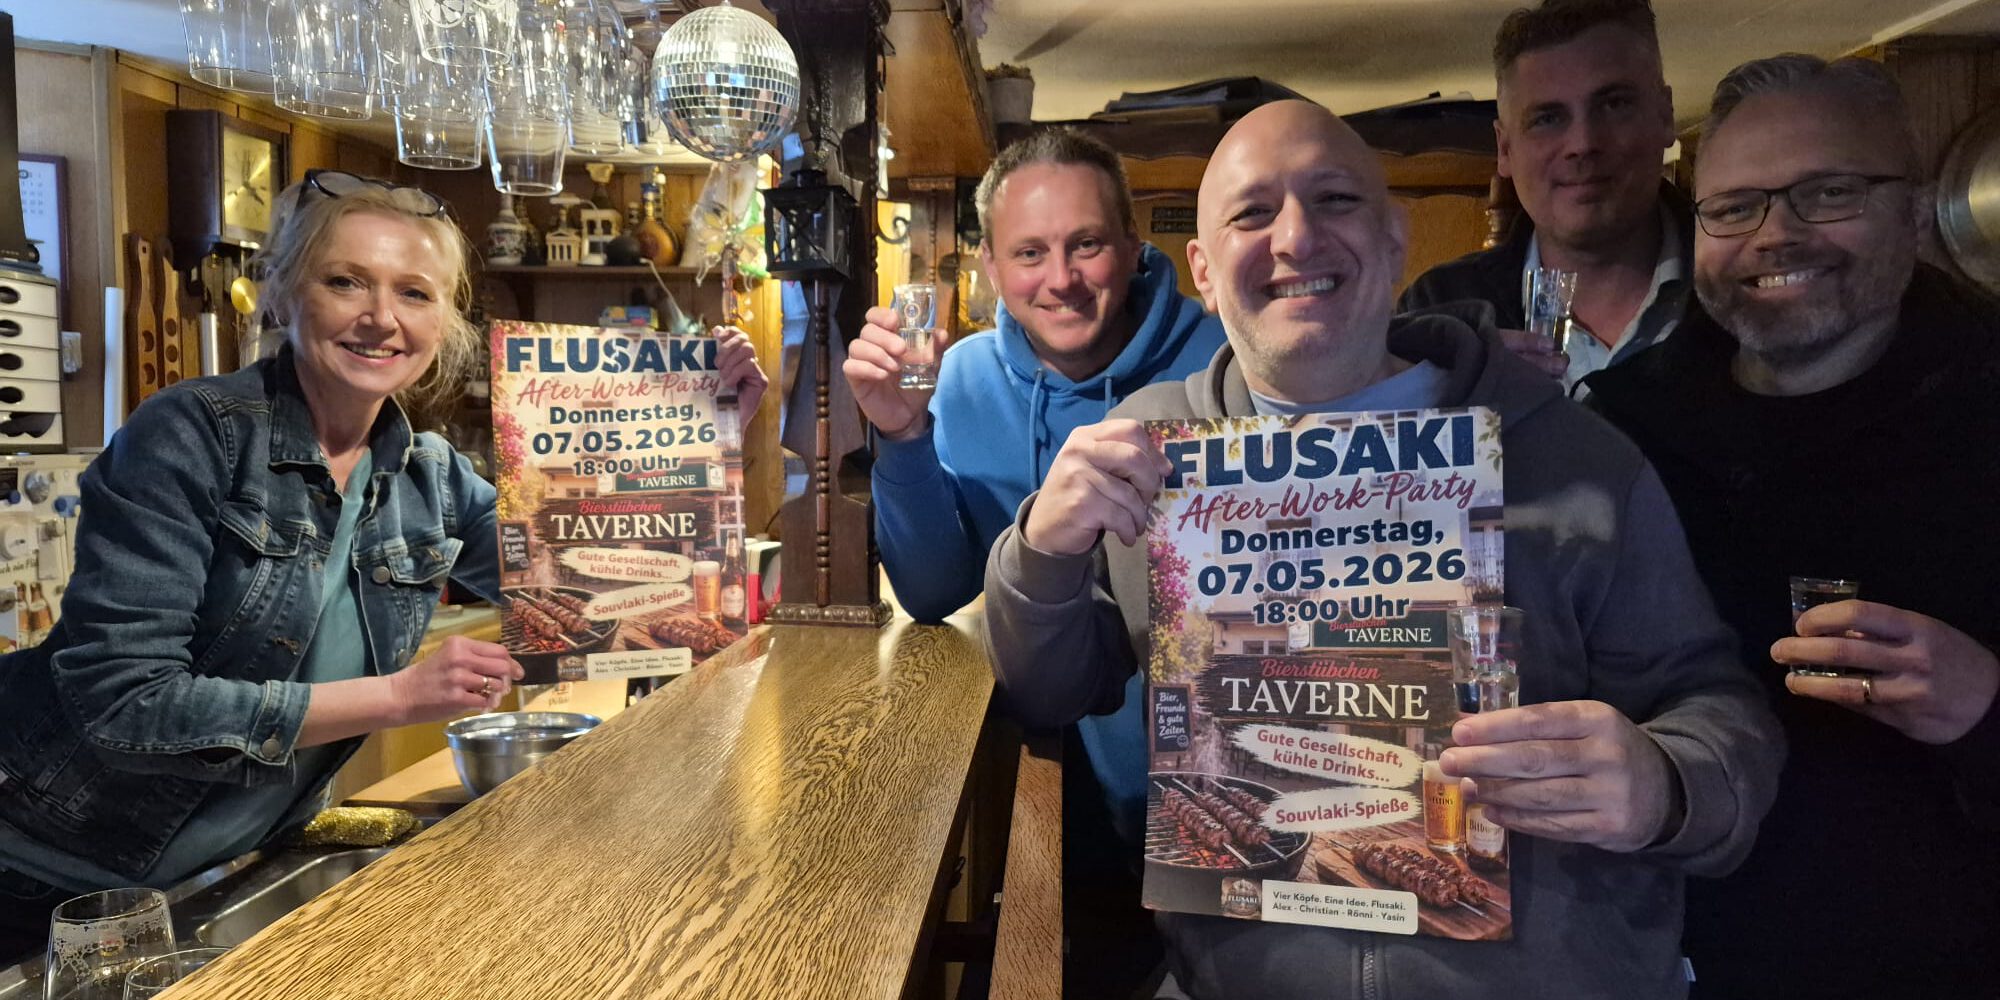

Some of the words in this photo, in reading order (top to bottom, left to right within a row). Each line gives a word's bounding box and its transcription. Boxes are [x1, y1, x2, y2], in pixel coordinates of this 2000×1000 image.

[506, 337, 719, 373] FLUSAKI
[516, 372, 720, 408] After-Work-Party
[550, 403, 701, 425] Donnerstag,
[533, 423, 716, 455] 07.05.2026
[1164, 415, 1475, 489] FLUSAKI
[573, 458, 634, 476] 18:00
[641, 455, 681, 471] Uhr
[640, 475, 697, 488] TAVERNE
[578, 500, 664, 514] Bierstübchen
[1177, 470, 1477, 534] After-Work-Party
[551, 512, 697, 540] TAVERNE
[1221, 518, 1444, 555] Donnerstag,
[577, 551, 605, 562] Gute
[608, 553, 680, 569] Gesellschaft,
[589, 564, 623, 575] kühle
[1198, 549, 1466, 597] 07.05.2026
[593, 589, 686, 616] Souvlaki-Spieße
[1253, 599, 1340, 624] 18:00
[1351, 594, 1411, 620] Uhr
[1345, 627, 1432, 643] TAVERNE
[1261, 659, 1382, 680] Bierstübchen
[1155, 702, 1186, 713] Freunde
[1158, 691, 1180, 703] Bier,
[1221, 676, 1431, 721] TAVERNE
[1158, 714, 1165, 724] &
[1166, 714, 1184, 726] gute
[1159, 725, 1186, 737] Zeiten
[1257, 729, 1295, 747] Gute
[1298, 736, 1403, 768] Gesellschaft,
[1273, 749, 1318, 769] kühle
[1322, 757, 1390, 782] Drinks...
[1276, 798, 1409, 824] Souvlaki-Spieße
[1272, 891, 1291, 900] Vier
[1293, 893, 1322, 904] Köpfe.
[1325, 895, 1344, 905] Eine
[1346, 897, 1368, 907] Idee.
[1371, 899, 1406, 910] Flusaki.
[1272, 902, 1291, 910] Alex
[1299, 904, 1339, 915] Christian
[1347, 908, 1373, 919] Rönni
[1381, 912, 1405, 922] Yasin
